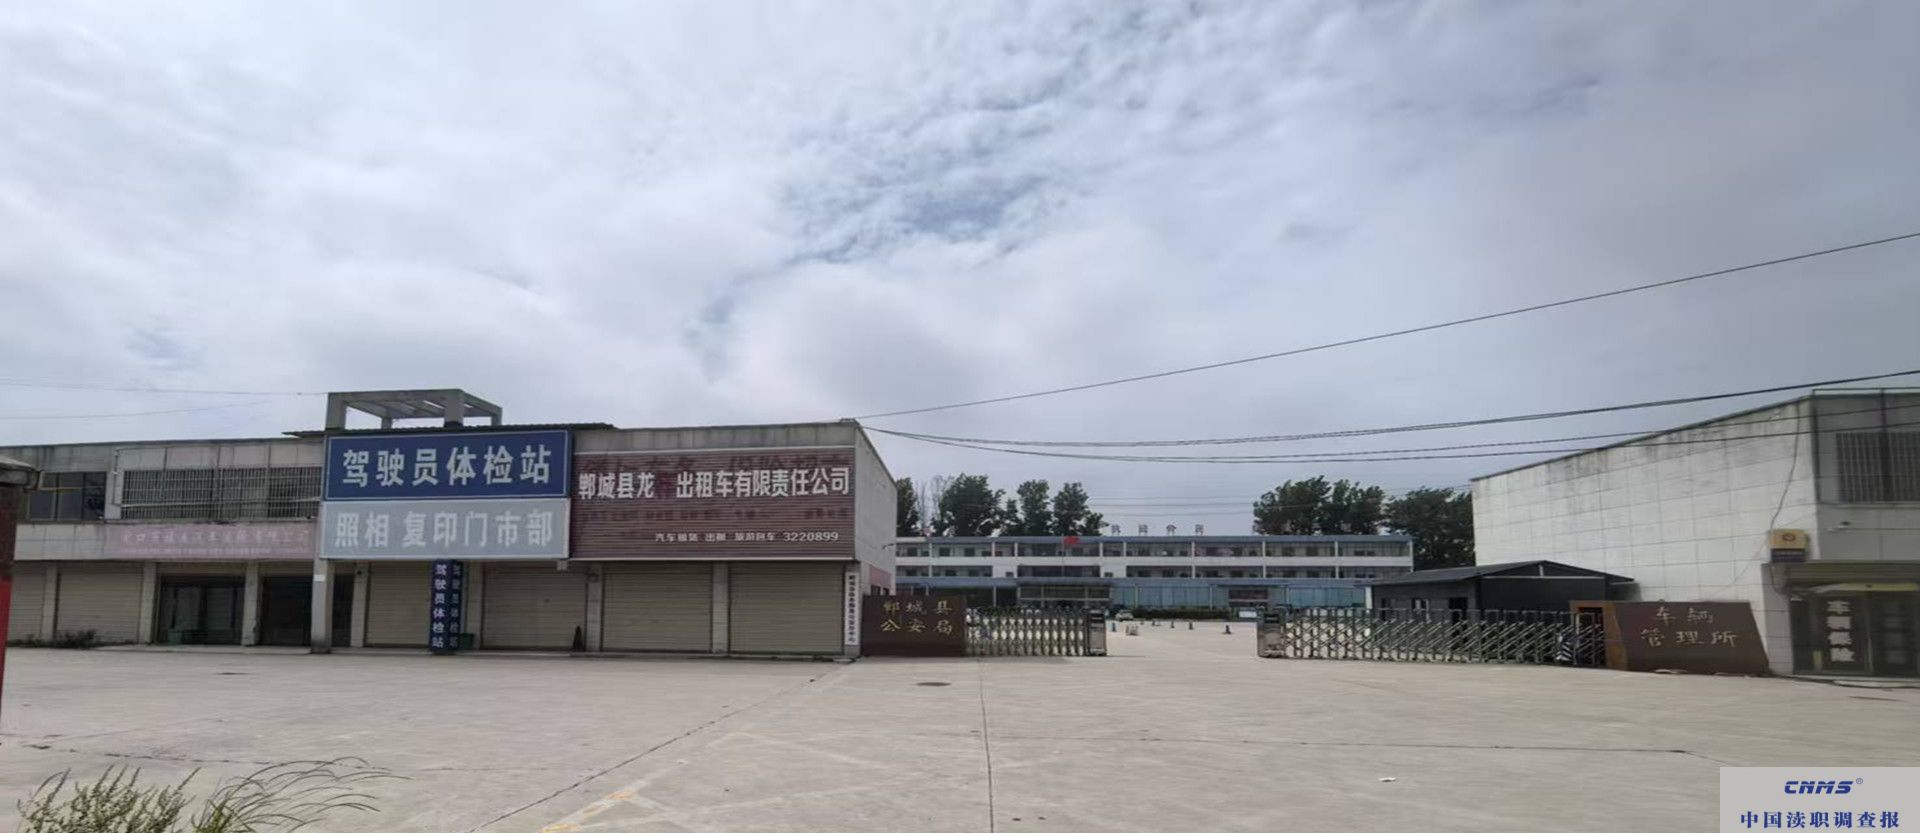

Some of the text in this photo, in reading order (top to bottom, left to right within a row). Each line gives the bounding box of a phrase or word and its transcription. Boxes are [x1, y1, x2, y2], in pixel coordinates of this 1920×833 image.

[342, 444, 552, 487] 驾驶员体检站
[334, 509, 553, 548] 照相 复印门市部
[783, 532, 839, 542] 3220899
[432, 564, 447, 648] 驾驶员体检站
[882, 600, 952, 616] 郸城县
[1655, 606, 1713, 625] 车辆
[880, 618, 952, 636] 公安局
[1641, 628, 1737, 648] 管理所
